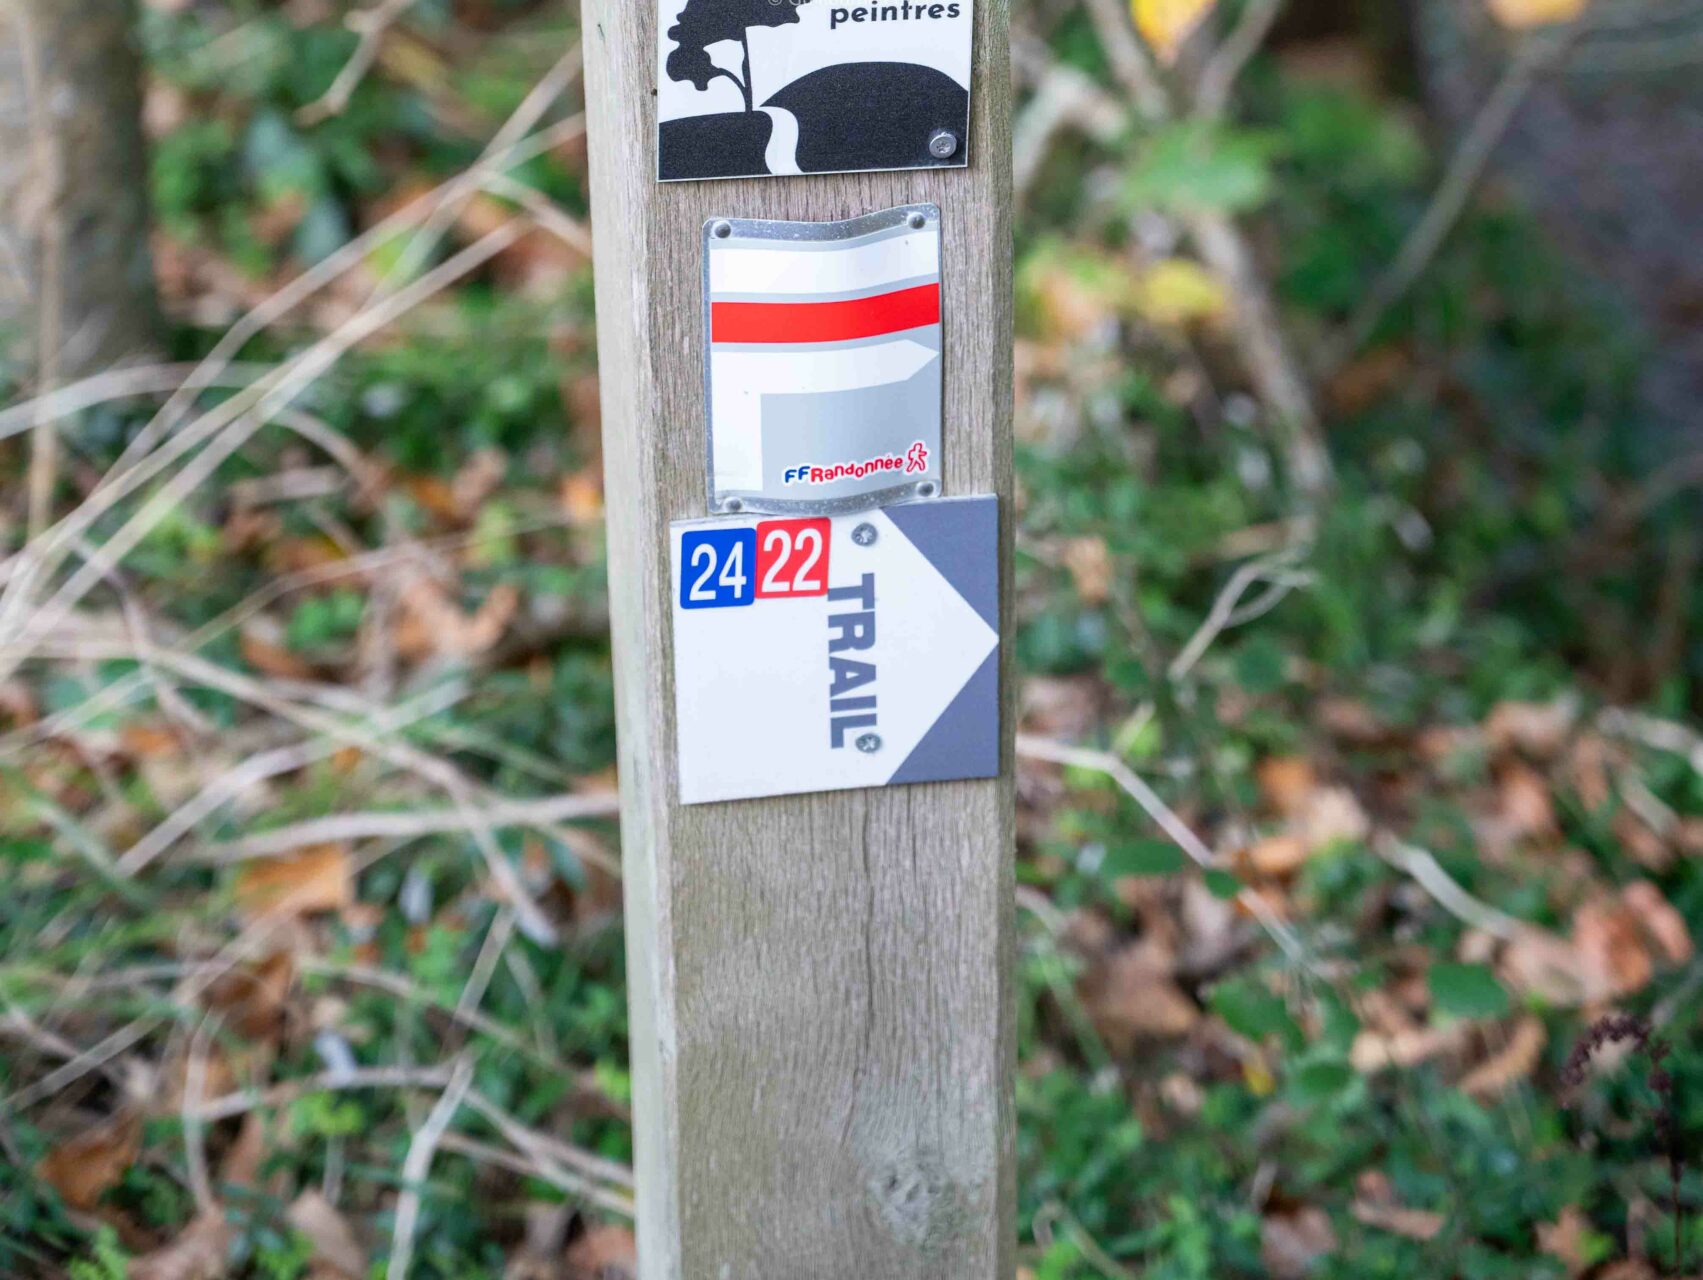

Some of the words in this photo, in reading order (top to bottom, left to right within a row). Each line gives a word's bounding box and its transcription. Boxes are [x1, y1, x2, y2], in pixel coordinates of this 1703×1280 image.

[830, 0, 961, 30] peintres
[689, 541, 747, 601] 24
[761, 528, 824, 593] 22
[826, 572, 878, 749] TRAIL
